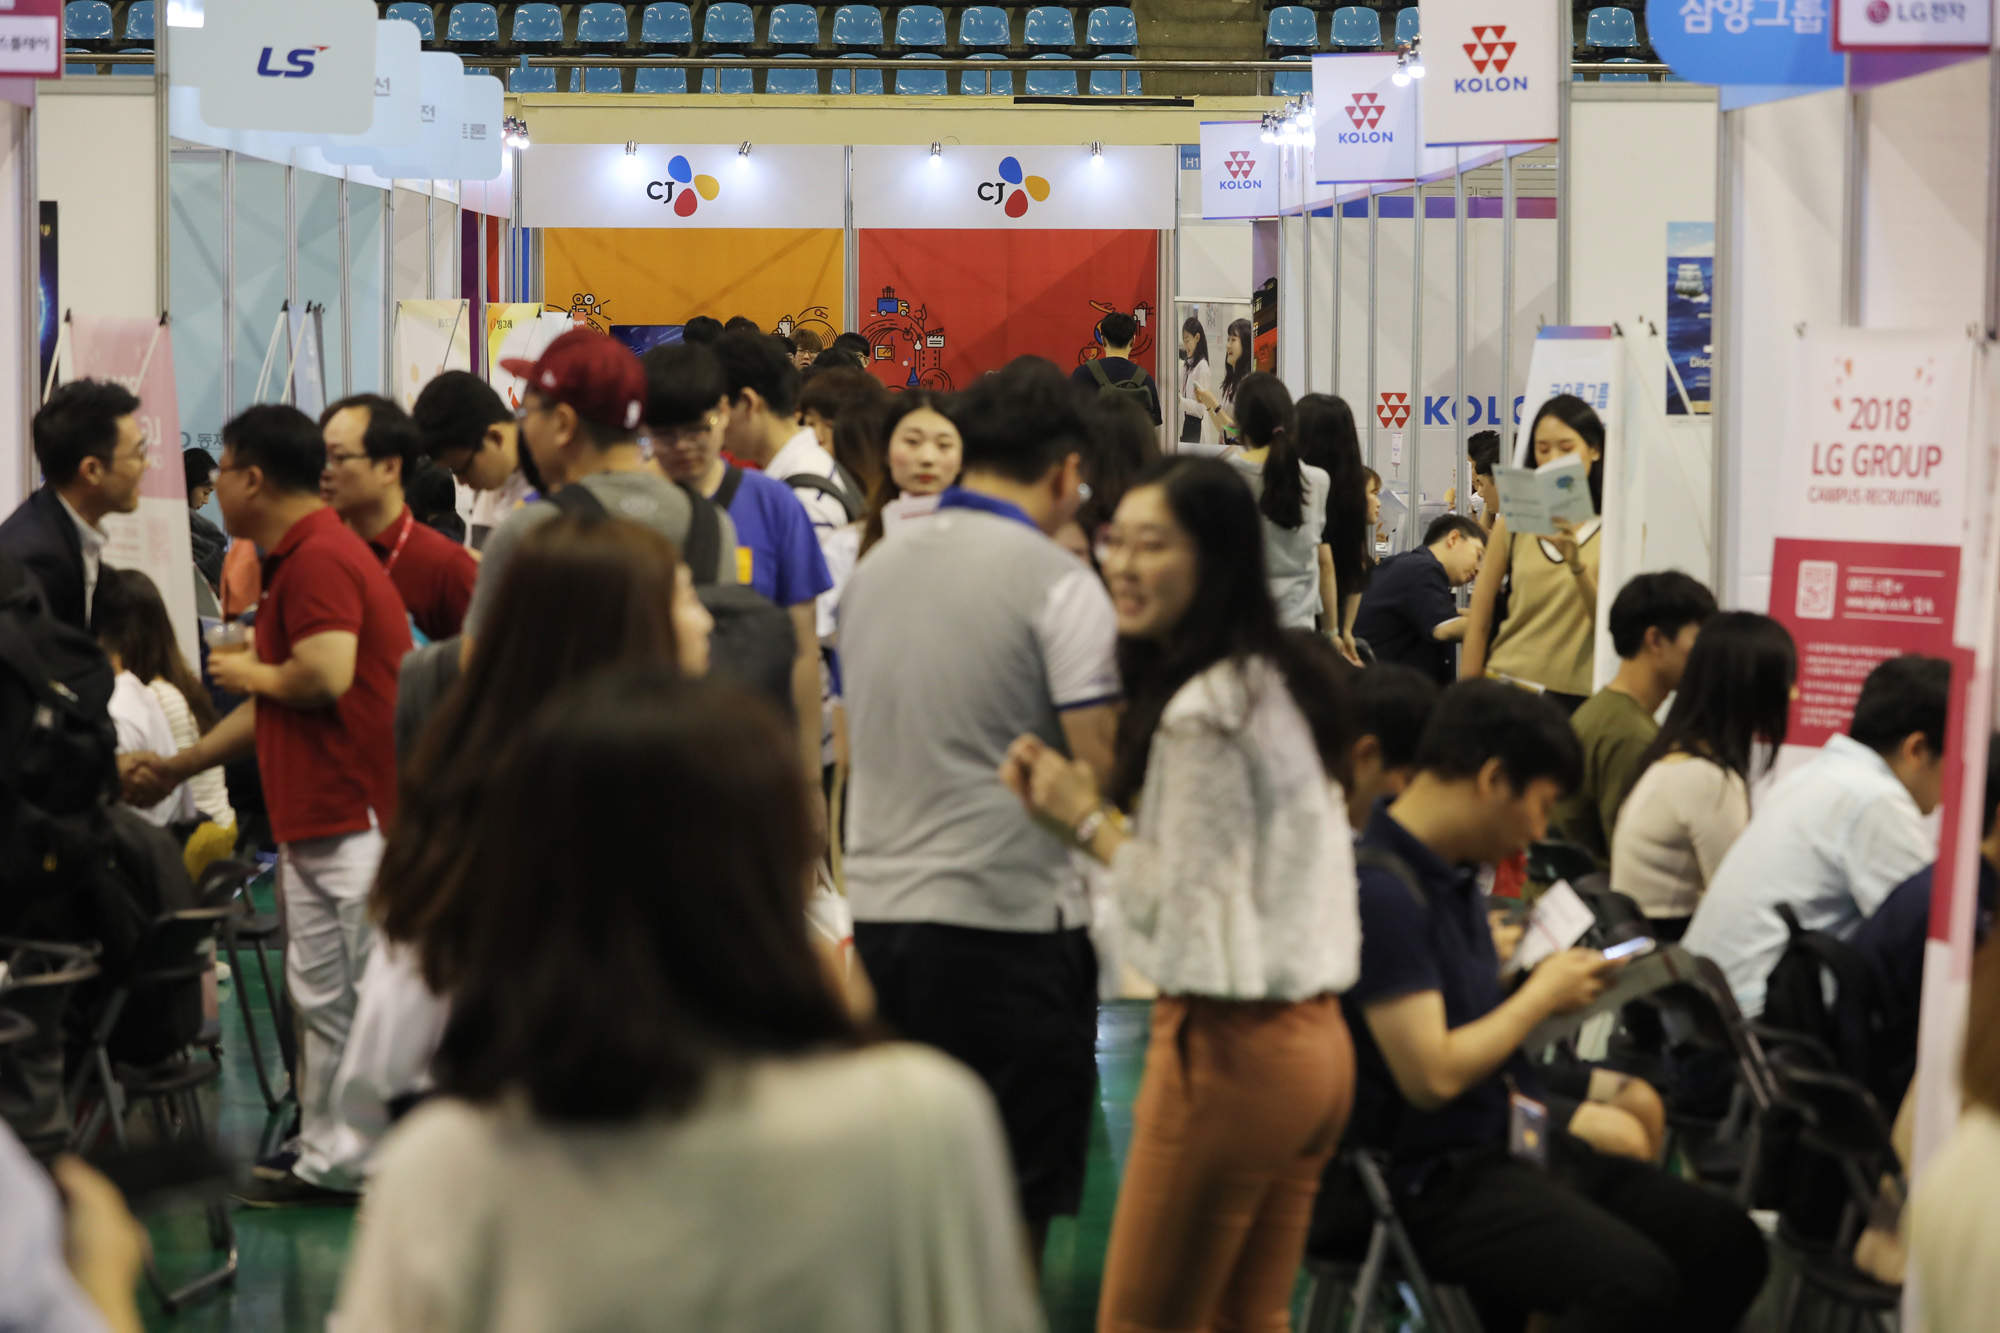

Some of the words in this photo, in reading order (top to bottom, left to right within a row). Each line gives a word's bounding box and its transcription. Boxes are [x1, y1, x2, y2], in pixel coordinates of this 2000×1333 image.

[257, 47, 316, 78] LS
[1454, 76, 1528, 93] KOLON
[1338, 131, 1394, 144] KOLON
[646, 181, 675, 204] CJ
[977, 182, 1006, 205] CJ
[1219, 180, 1262, 190] KOLON
[1849, 398, 1912, 431] 2018
[1811, 443, 1844, 476] LG
[1851, 444, 1943, 478] GROUP
